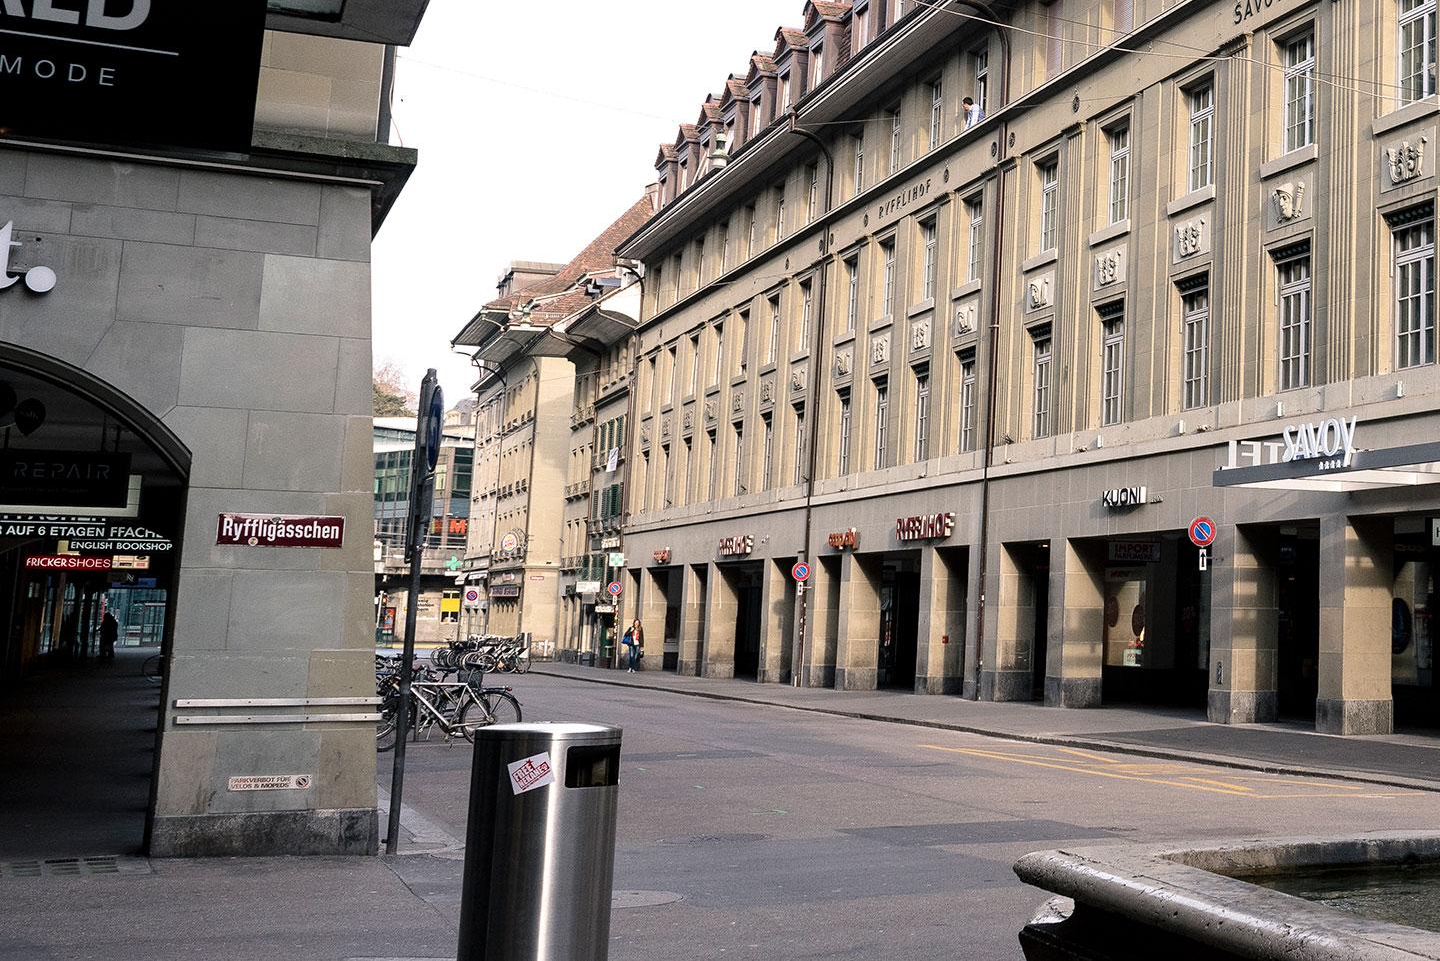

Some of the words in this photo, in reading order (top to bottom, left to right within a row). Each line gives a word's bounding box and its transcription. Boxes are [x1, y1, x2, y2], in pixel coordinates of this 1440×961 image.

[0, 55, 116, 86] MODE
[878, 179, 932, 220] RYFFLIHOF
[1282, 415, 1358, 468] SAVOY
[14, 462, 112, 479] REPAIR
[1103, 487, 1144, 507] KUONI
[6, 526, 35, 536] AUF
[38, 527, 46, 536] 6
[50, 527, 105, 537] ETAGEN
[222, 518, 339, 541] Ryffligässchen
[71, 541, 113, 550] ENGLISH
[116, 542, 173, 551] BOOKSHOP
[1115, 543, 1154, 553] IMPORT
